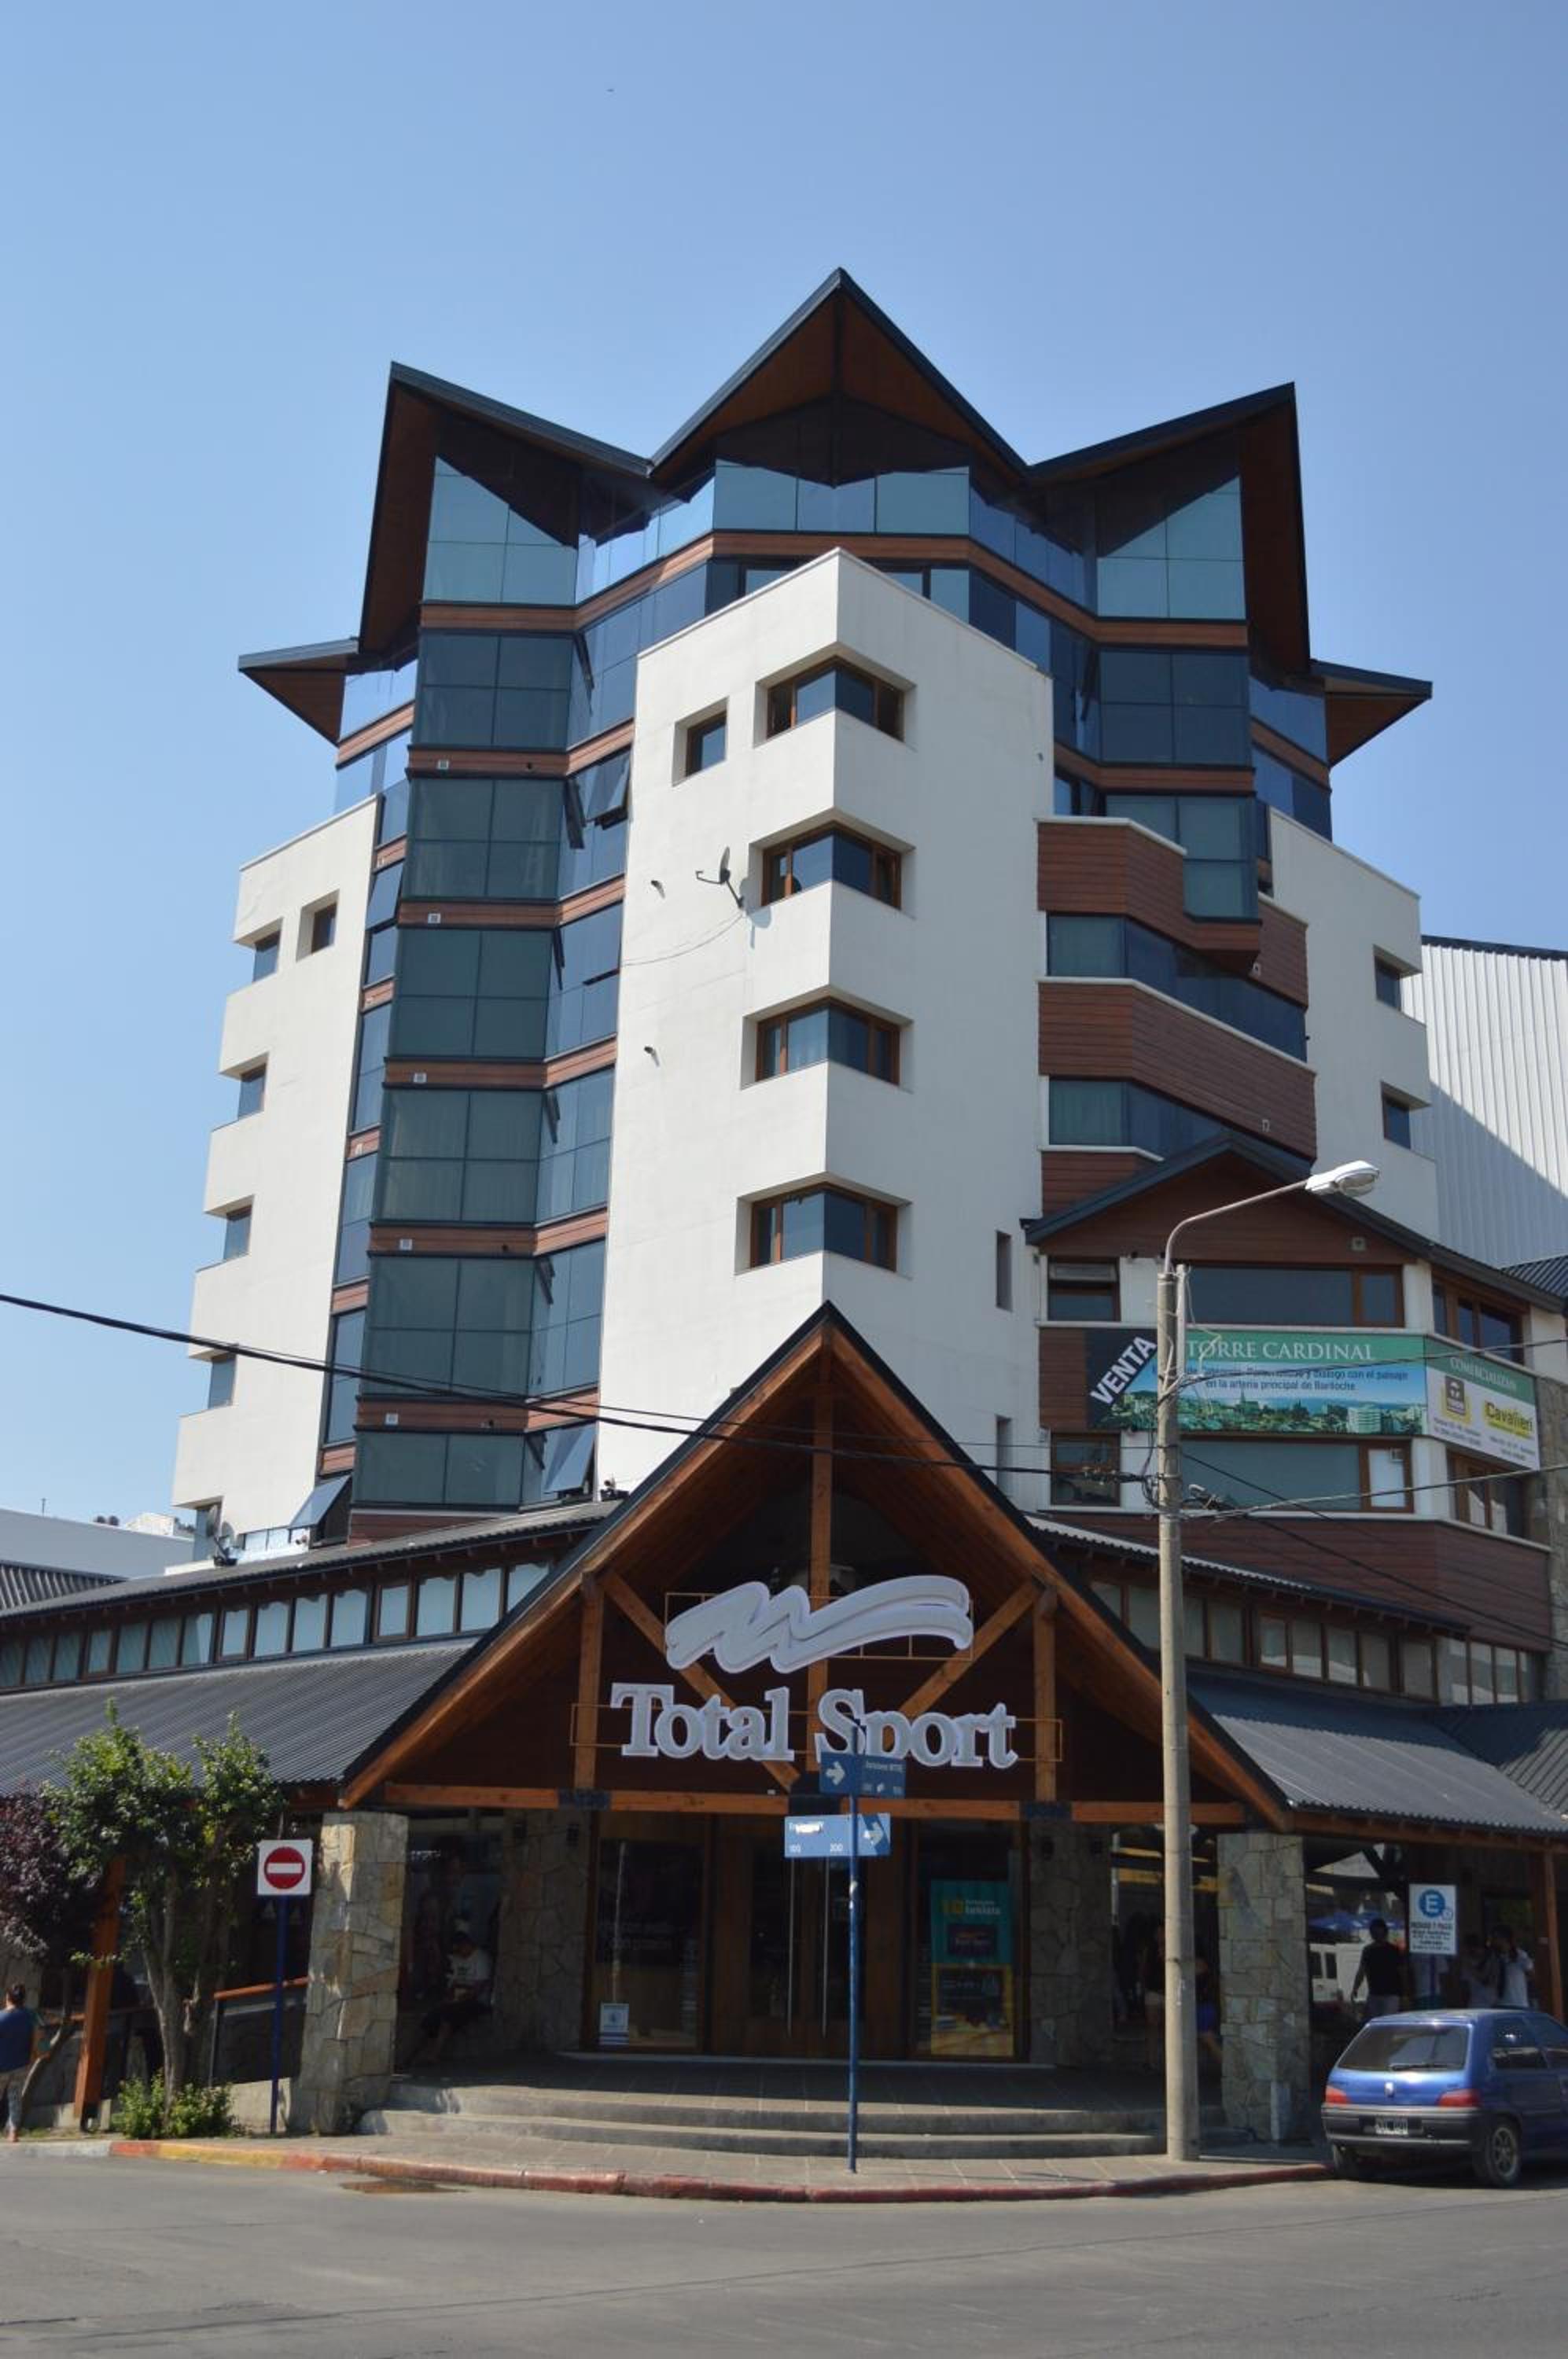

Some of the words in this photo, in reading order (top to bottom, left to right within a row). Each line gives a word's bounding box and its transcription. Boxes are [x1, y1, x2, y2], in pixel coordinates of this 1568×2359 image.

[1090, 1336, 1158, 1404] VENTA
[1186, 1339, 1257, 1359] TORRE
[609, 1681, 795, 1762] Total
[815, 1687, 1018, 1770] Sport
[1425, 1894, 1439, 1912] E
